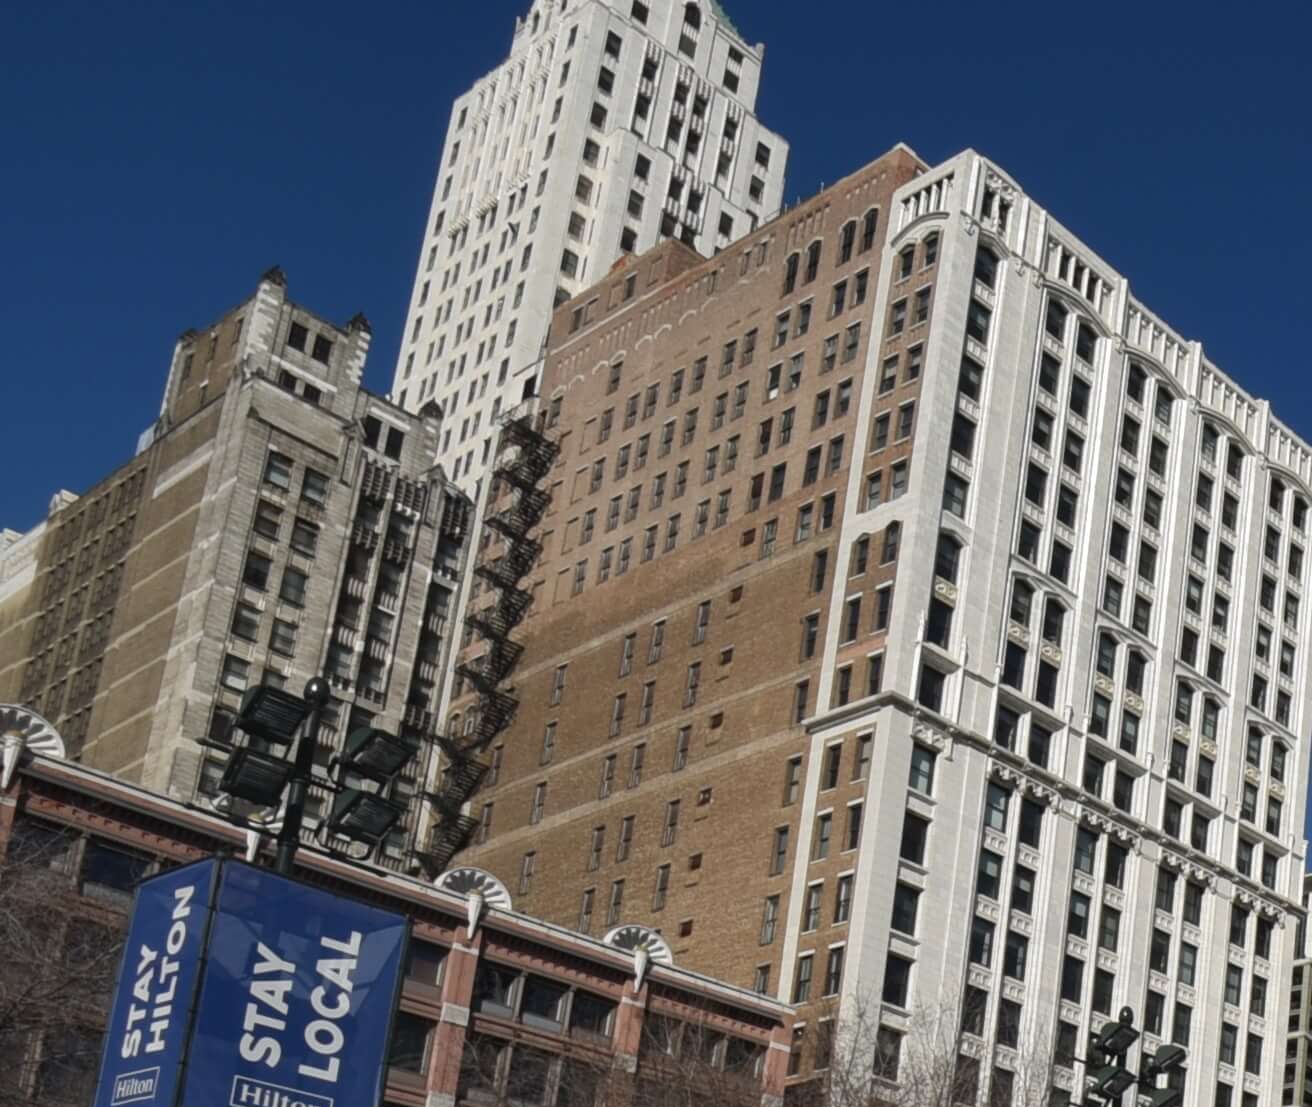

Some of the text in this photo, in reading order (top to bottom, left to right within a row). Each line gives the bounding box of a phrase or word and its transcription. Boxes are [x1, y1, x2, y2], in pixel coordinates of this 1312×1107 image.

[120, 944, 159, 1060] STAY
[145, 884, 195, 1053] HILTON
[239, 942, 297, 1069] STAY
[298, 929, 362, 1084] LOCAL
[116, 1074, 154, 1099] Hilton
